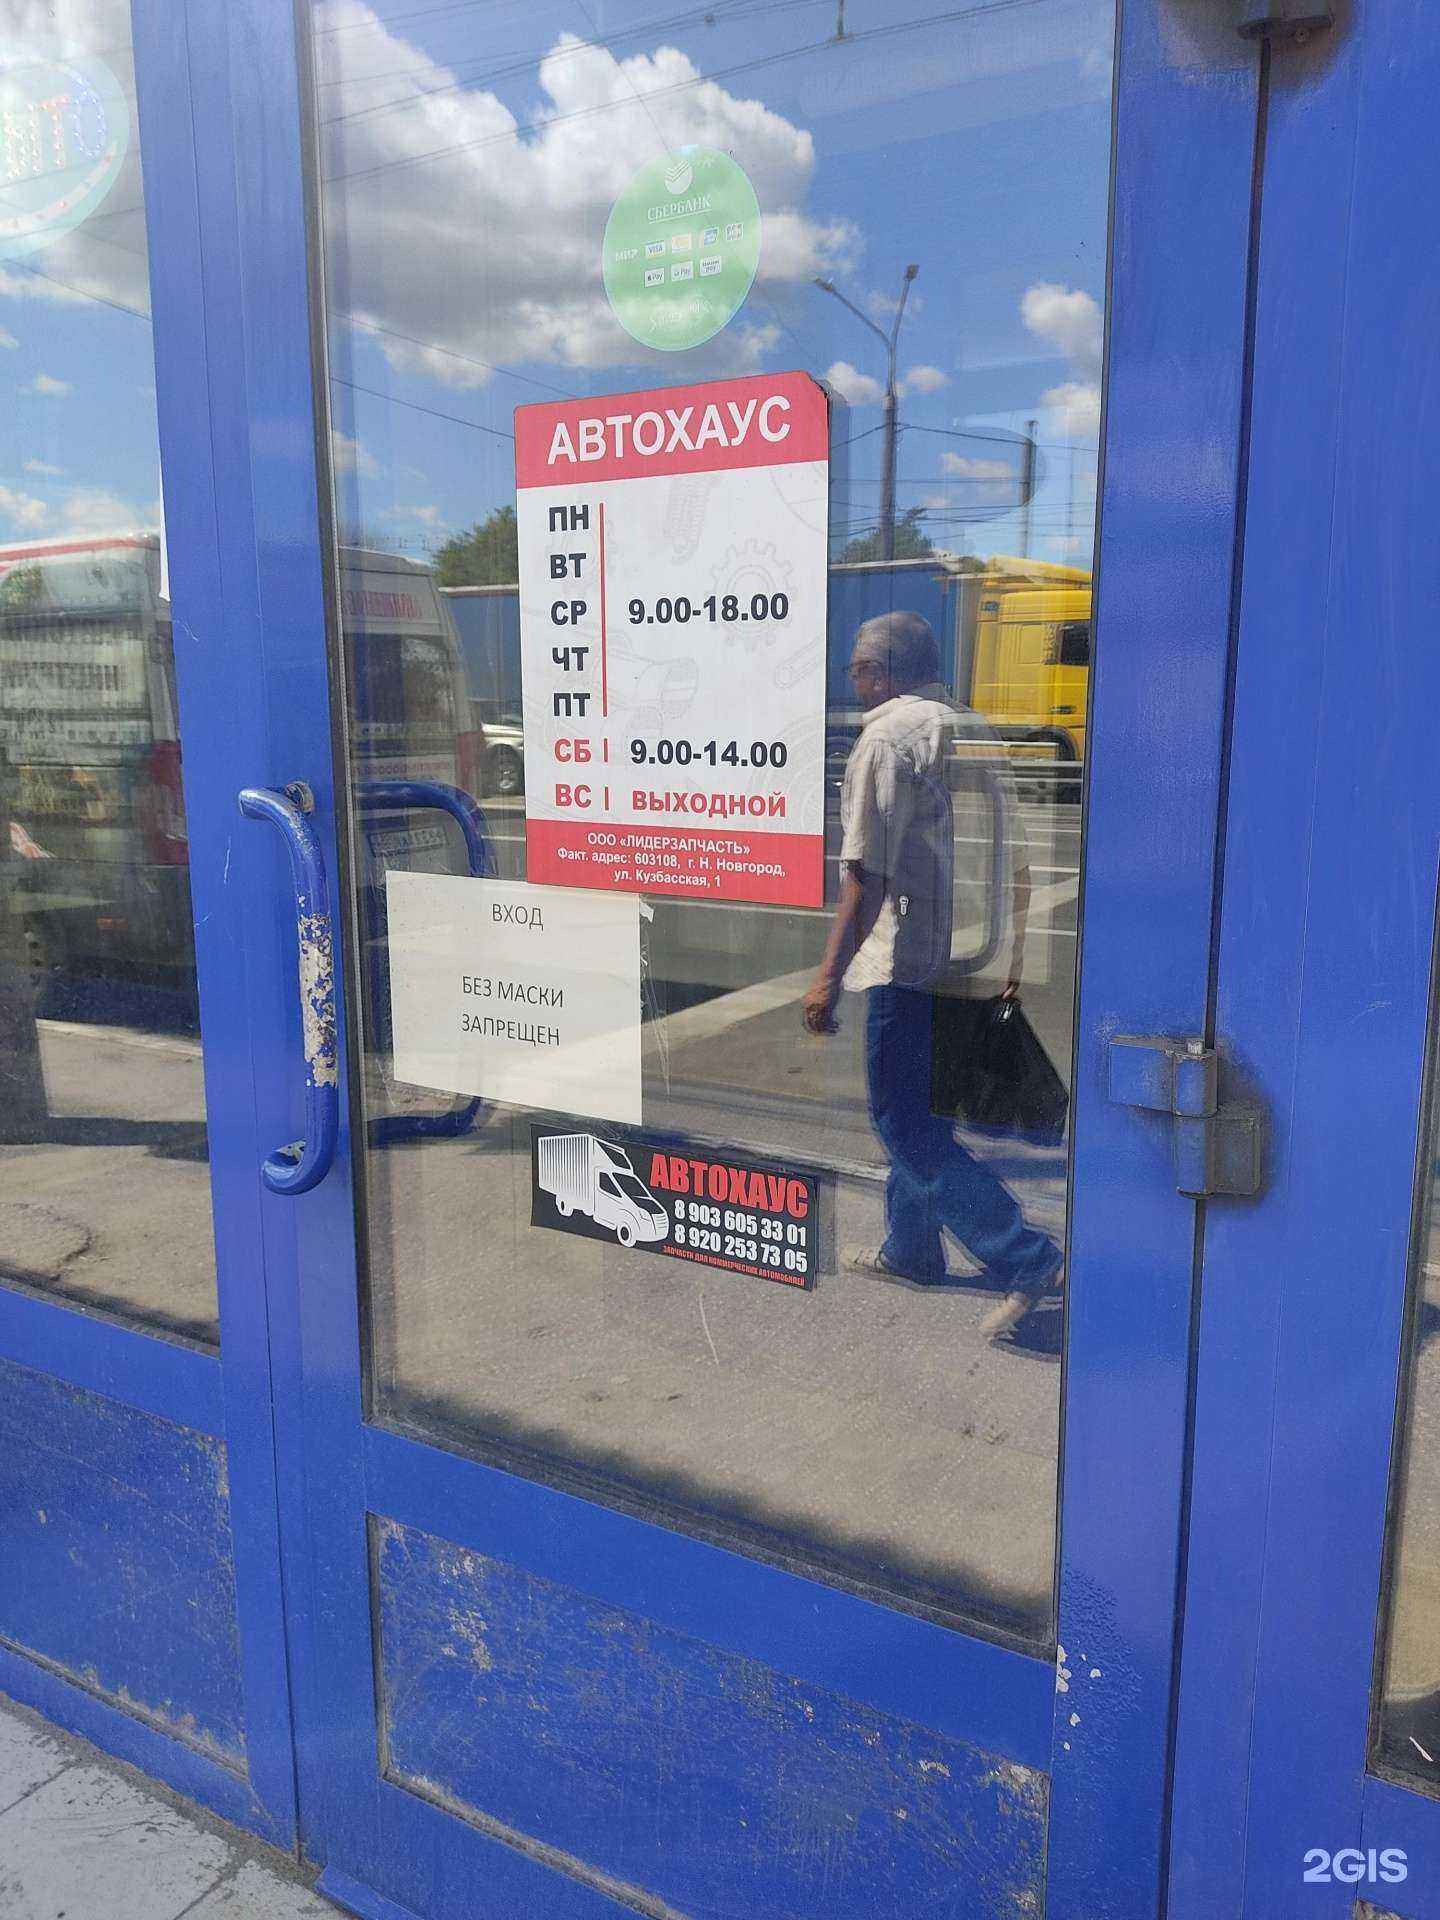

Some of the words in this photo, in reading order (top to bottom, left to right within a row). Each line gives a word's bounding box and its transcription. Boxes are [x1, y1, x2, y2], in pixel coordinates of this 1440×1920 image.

[647, 195, 712, 221] СБЕРБАНК
[648, 245, 663, 255] VISA
[547, 395, 791, 465] АВТОХАУС
[549, 504, 590, 532] ПН
[549, 553, 587, 579] ВТ
[550, 600, 587, 625] СР
[628, 593, 789, 624] 9.00-18.00
[552, 647, 590, 671] ЧТ
[553, 692, 591, 717] ПТ
[553, 738, 591, 763] СБ
[630, 739, 788, 768] 9.00-14.00
[555, 783, 592, 809] ВС
[632, 790, 787, 818] ВЫХОДНОЙ
[587, 832, 616, 846] ООО
[620, 834, 751, 855] «ЛИДЕРЗАПЧАСТЬ»
[557, 847, 590, 861] Факт.
[592, 852, 631, 865] адрес:
[635, 853, 681, 869] 603108,
[688, 858, 697, 869] г.
[700, 858, 713, 870] Н.
[716, 859, 786, 876] Новгород,
[613, 870, 632, 882] ул.
[635, 870, 711, 887] Кузбасская,
[714, 875, 721, 887] 1
[491, 903, 544, 931] ВХОД
[462, 976, 492, 997] БЕЗ
[497, 981, 564, 1008] МАСКИ
[461, 1013, 560, 1047] ЗАПРЕЩЕН
[649, 1153, 808, 1218] АВТОХАУС
[674, 1199, 686, 1219] 8
[688, 1202, 721, 1227] 903
[724, 1210, 758, 1235] 605
[760, 1217, 783, 1241] 33
[786, 1224, 807, 1247] 01
[674, 1223, 686, 1244] 8
[688, 1227, 721, 1252] 920
[724, 1235, 758, 1261] 253
[760, 1243, 781, 1266] 73
[784, 1248, 808, 1272] 05
